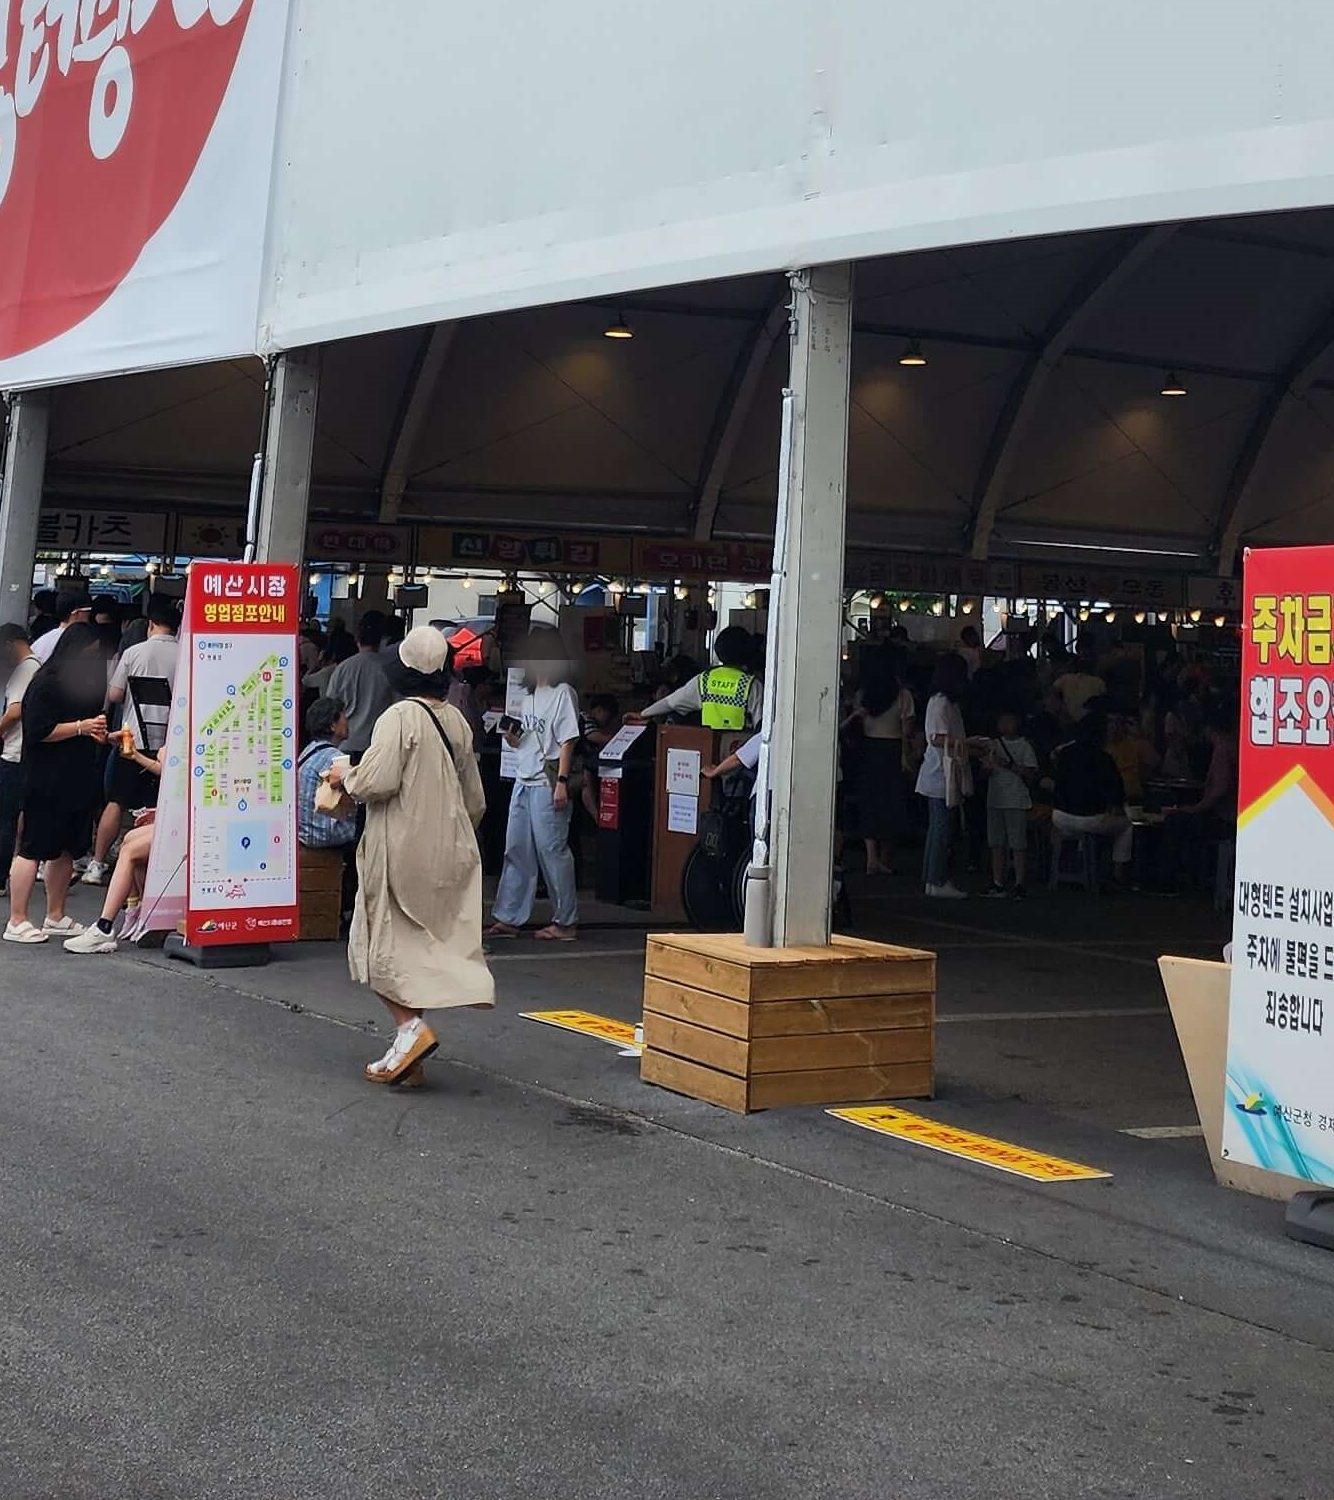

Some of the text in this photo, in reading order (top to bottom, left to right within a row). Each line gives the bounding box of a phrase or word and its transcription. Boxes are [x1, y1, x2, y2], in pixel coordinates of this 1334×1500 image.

[203, 574, 287, 598] 예산시장
[204, 603, 286, 623] 영업점포안내
[710, 678, 736, 690] STAFF
[1238, 881, 1284, 920] 대형텐트
[1247, 933, 1281, 974] 주차에
[1285, 939, 1319, 980] 불편을
[1265, 989, 1324, 1037] 죄송합니다
[1273, 1103, 1313, 1129] 예산군청
